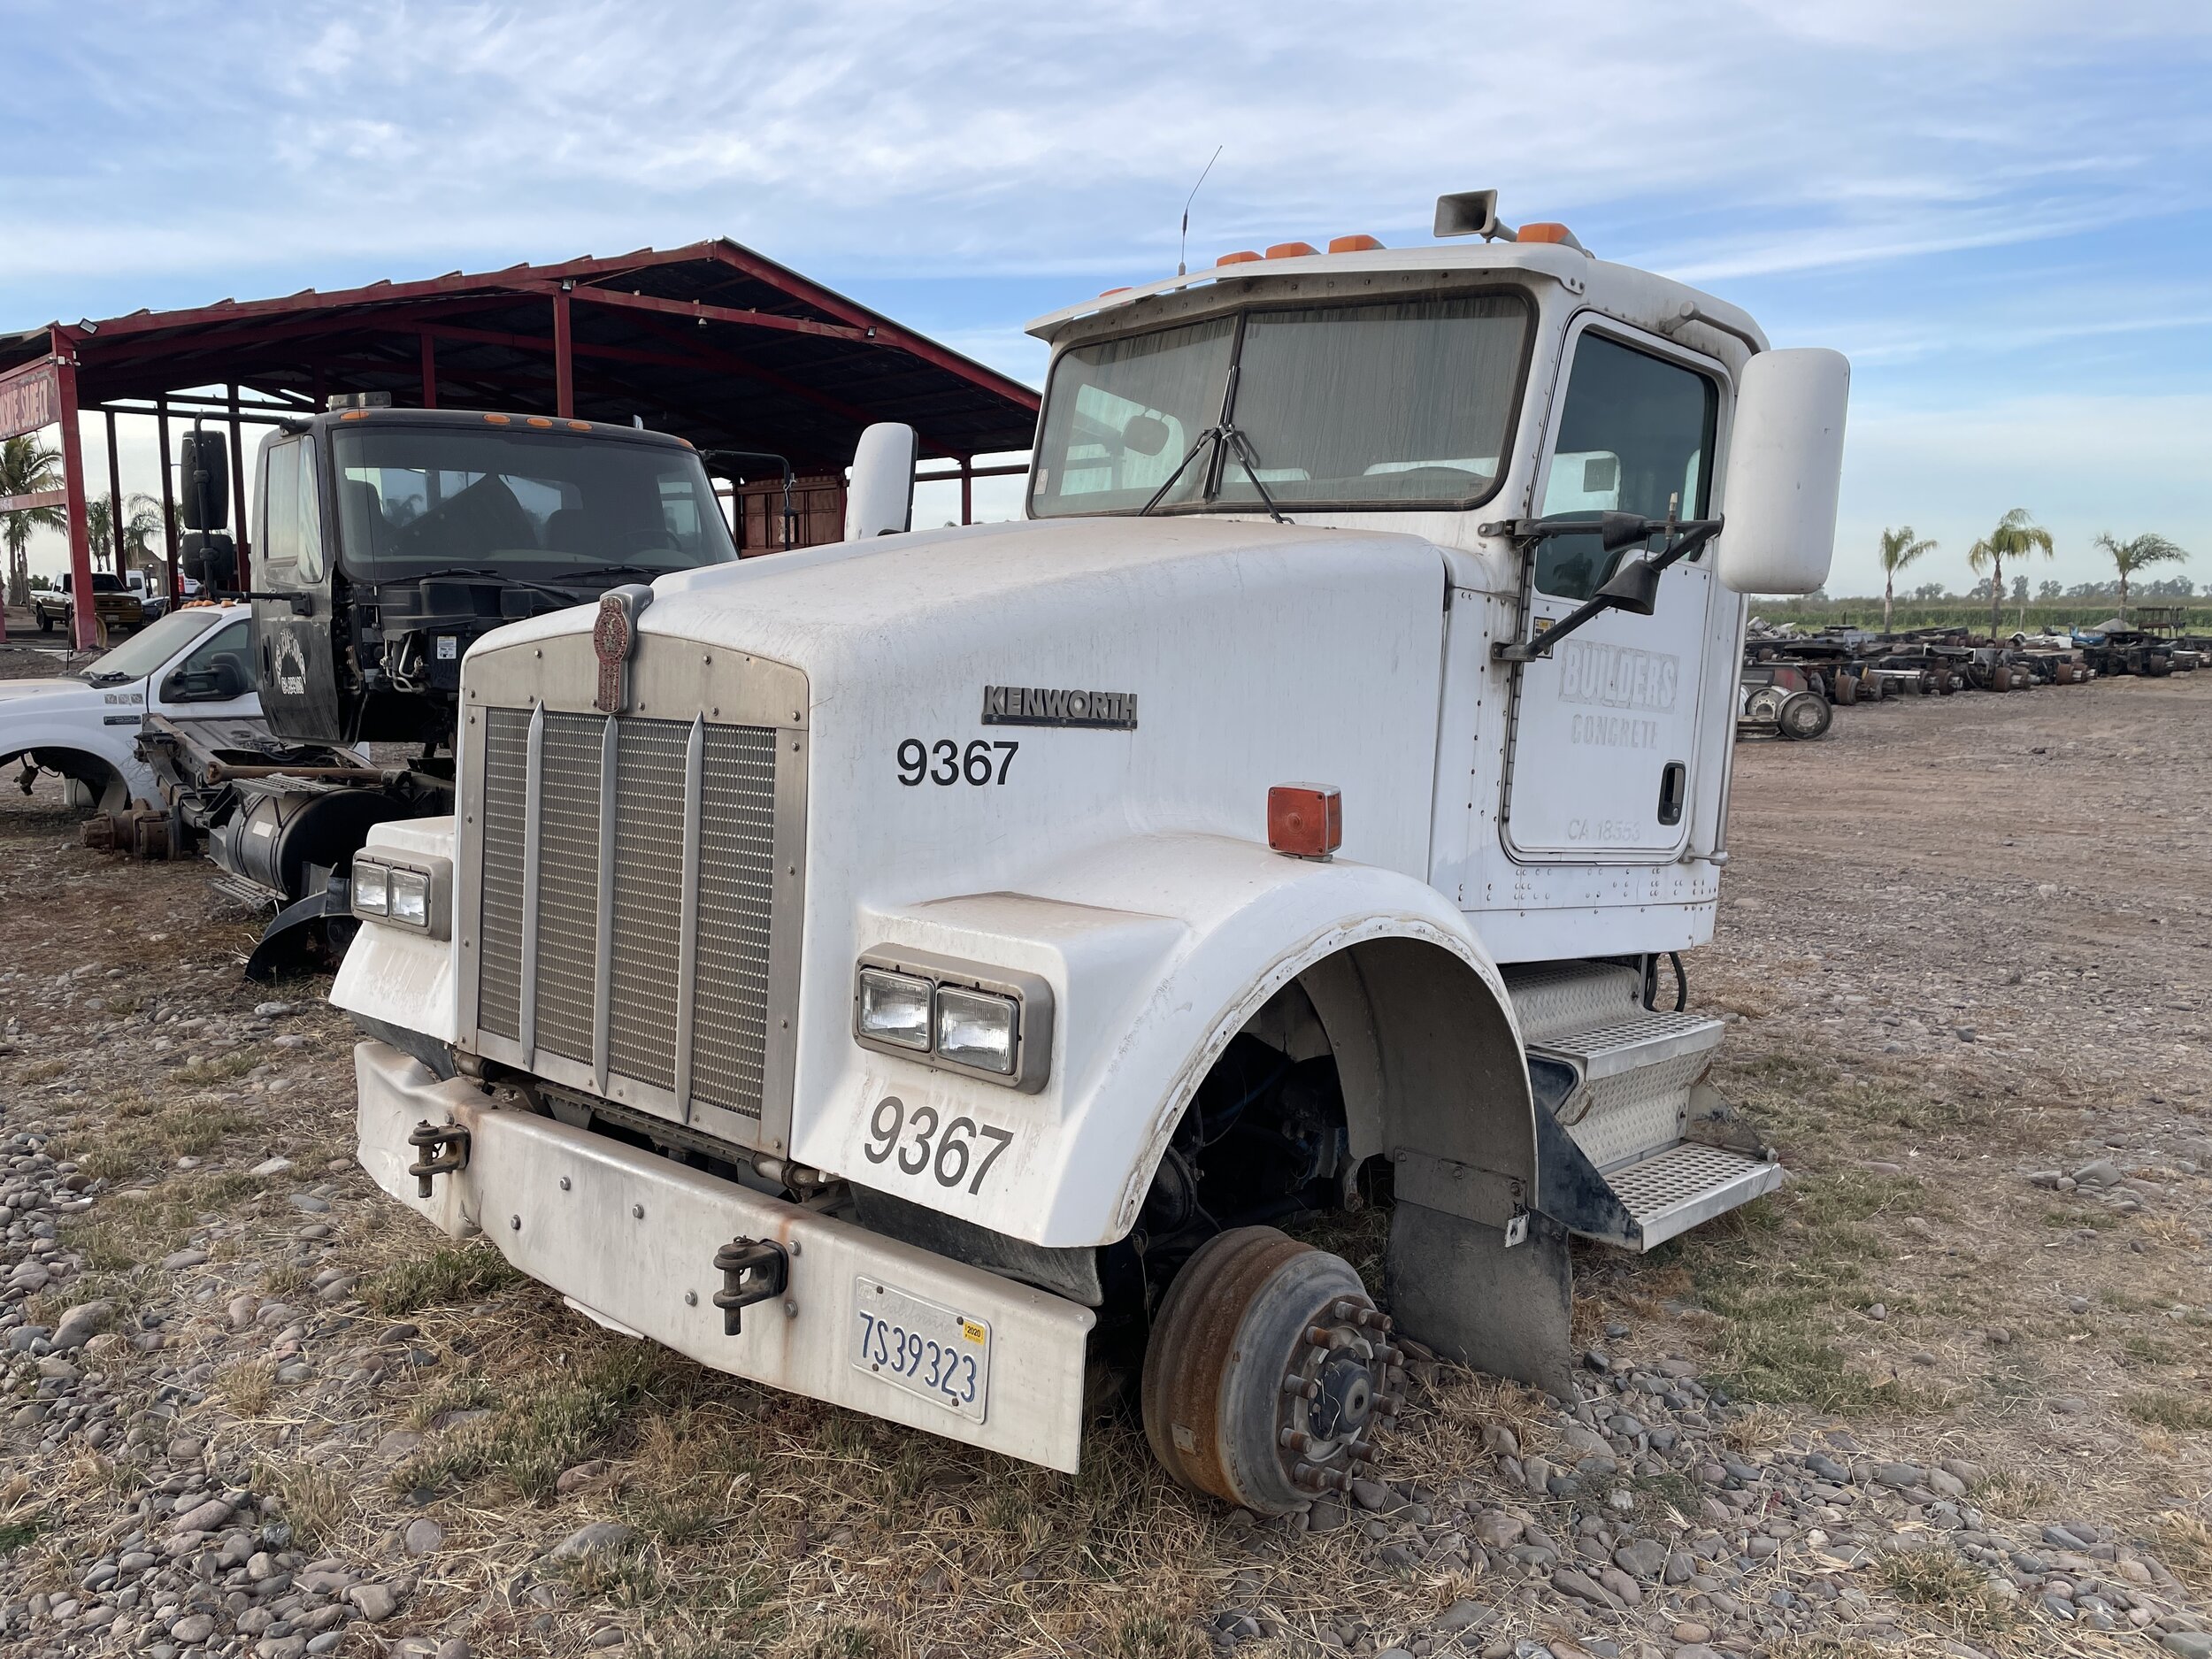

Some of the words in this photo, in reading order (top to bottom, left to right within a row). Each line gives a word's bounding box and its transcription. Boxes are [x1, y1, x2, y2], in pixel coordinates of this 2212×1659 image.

[1561, 643, 1676, 709] BUILDERS
[983, 685, 1138, 720] KENWORTH
[1571, 713, 1657, 749] CONCRETE
[897, 738, 1019, 787] 9367
[864, 1095, 1015, 1196] 9367
[859, 1309, 977, 1403] 7S39323
[966, 1325, 981, 1339] 2020
